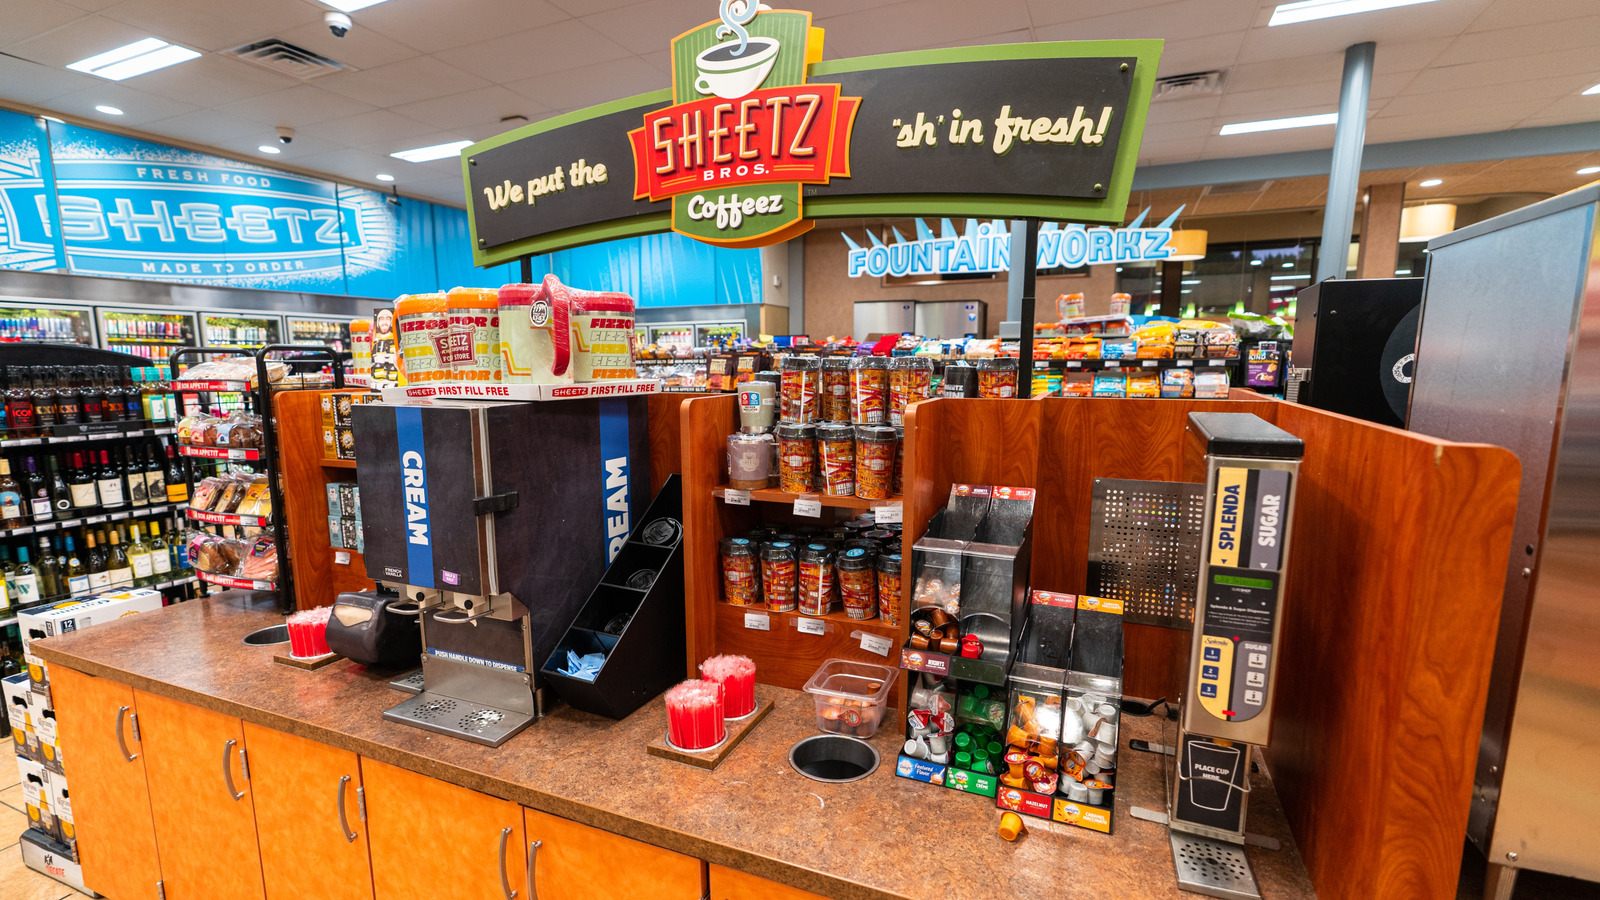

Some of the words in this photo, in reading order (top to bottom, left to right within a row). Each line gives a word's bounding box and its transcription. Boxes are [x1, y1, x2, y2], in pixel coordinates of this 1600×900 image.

[653, 94, 823, 176] SHEETZ
[948, 108, 984, 145] in
[992, 104, 1113, 155] fresh!
[136, 167, 209, 182] FRESH
[220, 172, 272, 188] FOOD
[702, 163, 770, 182] BROS.
[483, 179, 524, 212] We
[526, 165, 567, 207] put
[569, 158, 608, 188] the
[687, 192, 784, 230] Coffeez
[36, 194, 351, 244] SHEETZ
[1036, 228, 1171, 269] WORKZ
[142, 262, 203, 274] MADE
[215, 263, 236, 274] TO
[245, 259, 305, 273] ORDER
[590, 318, 635, 329] FIZZO
[591, 343, 629, 354] FIZZ
[407, 387, 436, 397] SHEETZ
[438, 386, 462, 396] FIRST
[464, 386, 484, 396] FILL
[485, 386, 510, 396] FREE
[554, 387, 588, 397] SHEETZ
[591, 385, 616, 395] FIRST
[617, 384, 634, 394] FILL
[636, 383, 656, 393] FREE
[198, 449, 218, 457] APPETIT
[402, 450, 430, 546] CREAM
[604, 456, 630, 564] REAM
[1218, 484, 1241, 551] SPLENDA
[206, 514, 226, 522] APPETIT
[1257, 494, 1281, 548] SUGAR
[63, 619, 74, 628] 12
[1244, 643, 1268, 651] SUGAR
[434, 649, 448, 659] PUSH
[448, 653, 468, 662] HANDLE
[468, 656, 484, 666] DOWN
[492, 661, 518, 673] DISPENSE
[914, 762, 934, 773] Featured
[916, 769, 931, 777] Flavor
[1194, 763, 1216, 773] PLACE
[1215, 767, 1230, 776] CUP
[1025, 799, 1048, 809] HAZELNUT
[1085, 811, 1106, 821] CARAMEL
